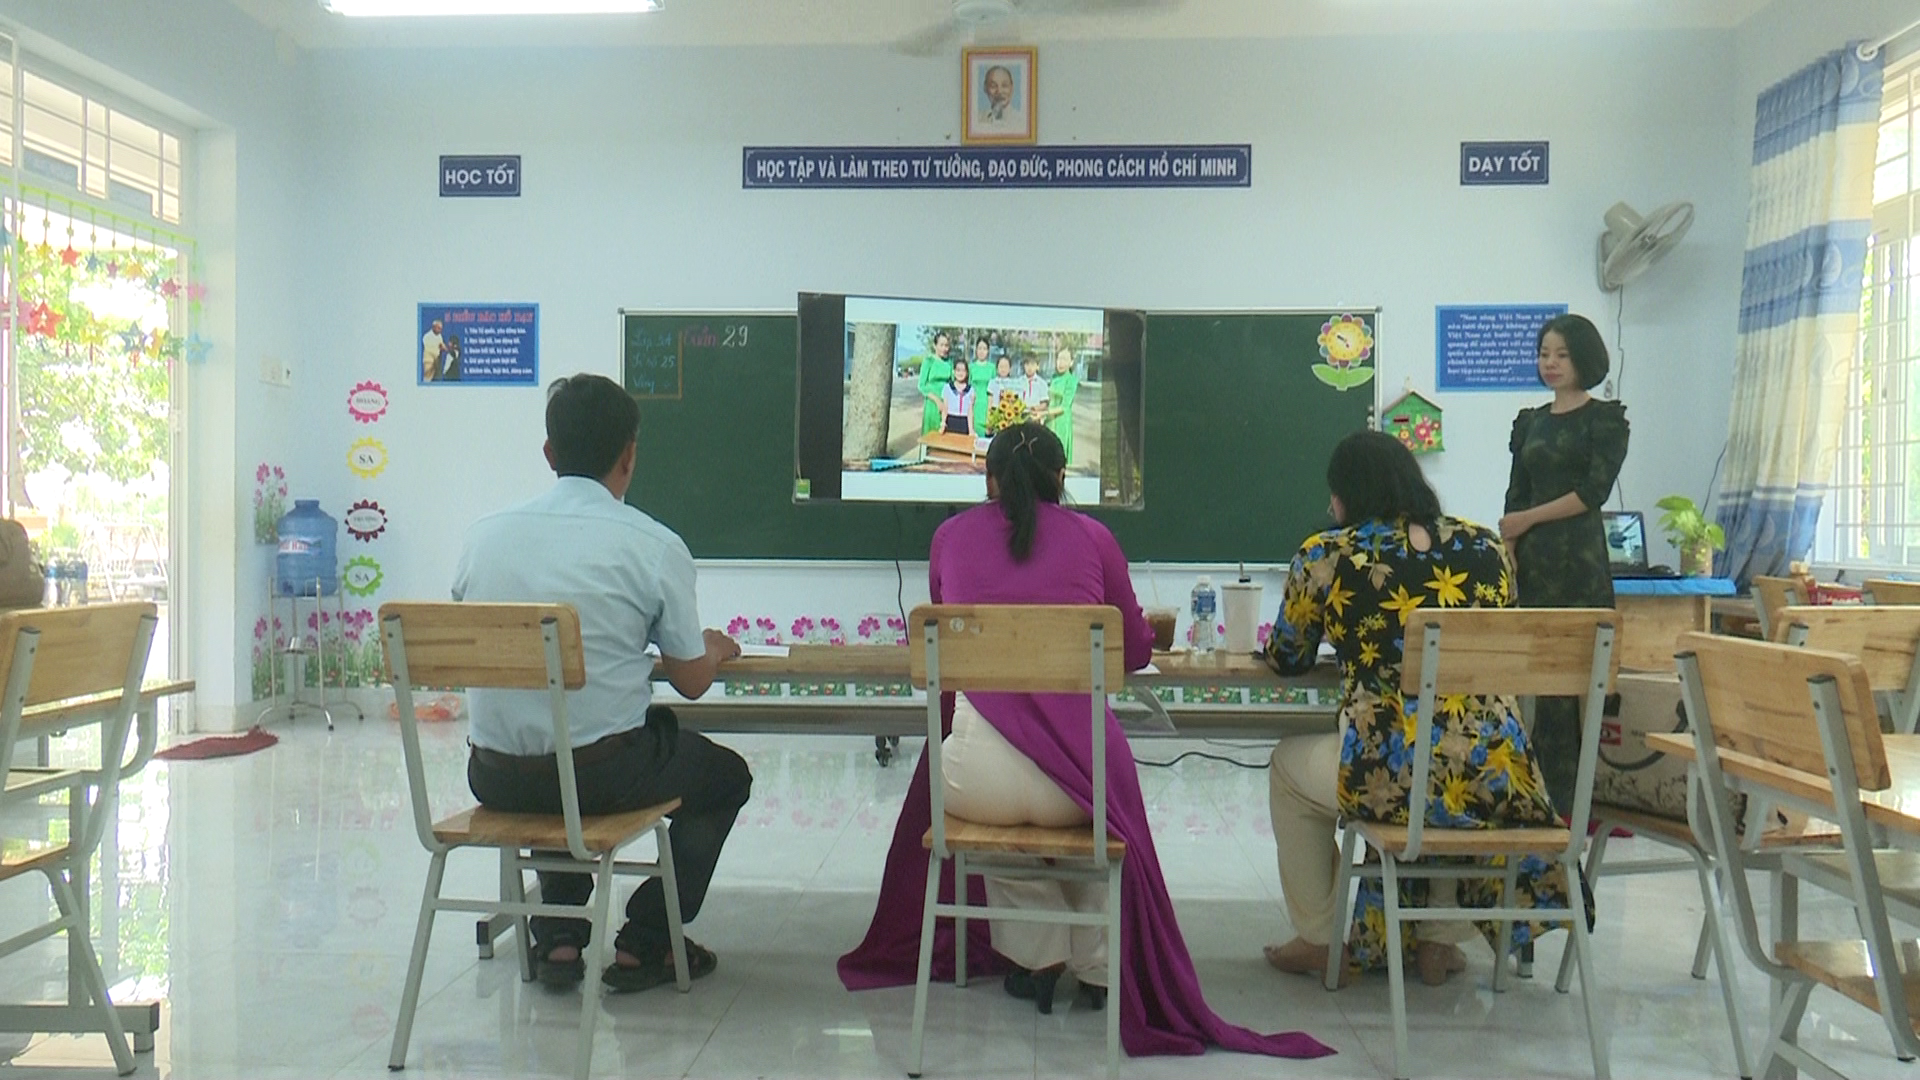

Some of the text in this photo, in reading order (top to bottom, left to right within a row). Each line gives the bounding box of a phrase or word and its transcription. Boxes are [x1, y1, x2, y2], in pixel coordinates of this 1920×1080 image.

[757, 151, 1237, 183] HỌC TẬP VÀ LÀM THEO TƯ TƯỞNG, ĐẠO ĐỨC, PHONG CÁCH HỒ CHÍ MINH
[1468, 149, 1541, 177] DẠY TỐT
[445, 163, 515, 189] HỌC TỐT
[721, 325, 748, 348] 29
[359, 454, 374, 464] SA
[355, 573, 370, 583] SA
